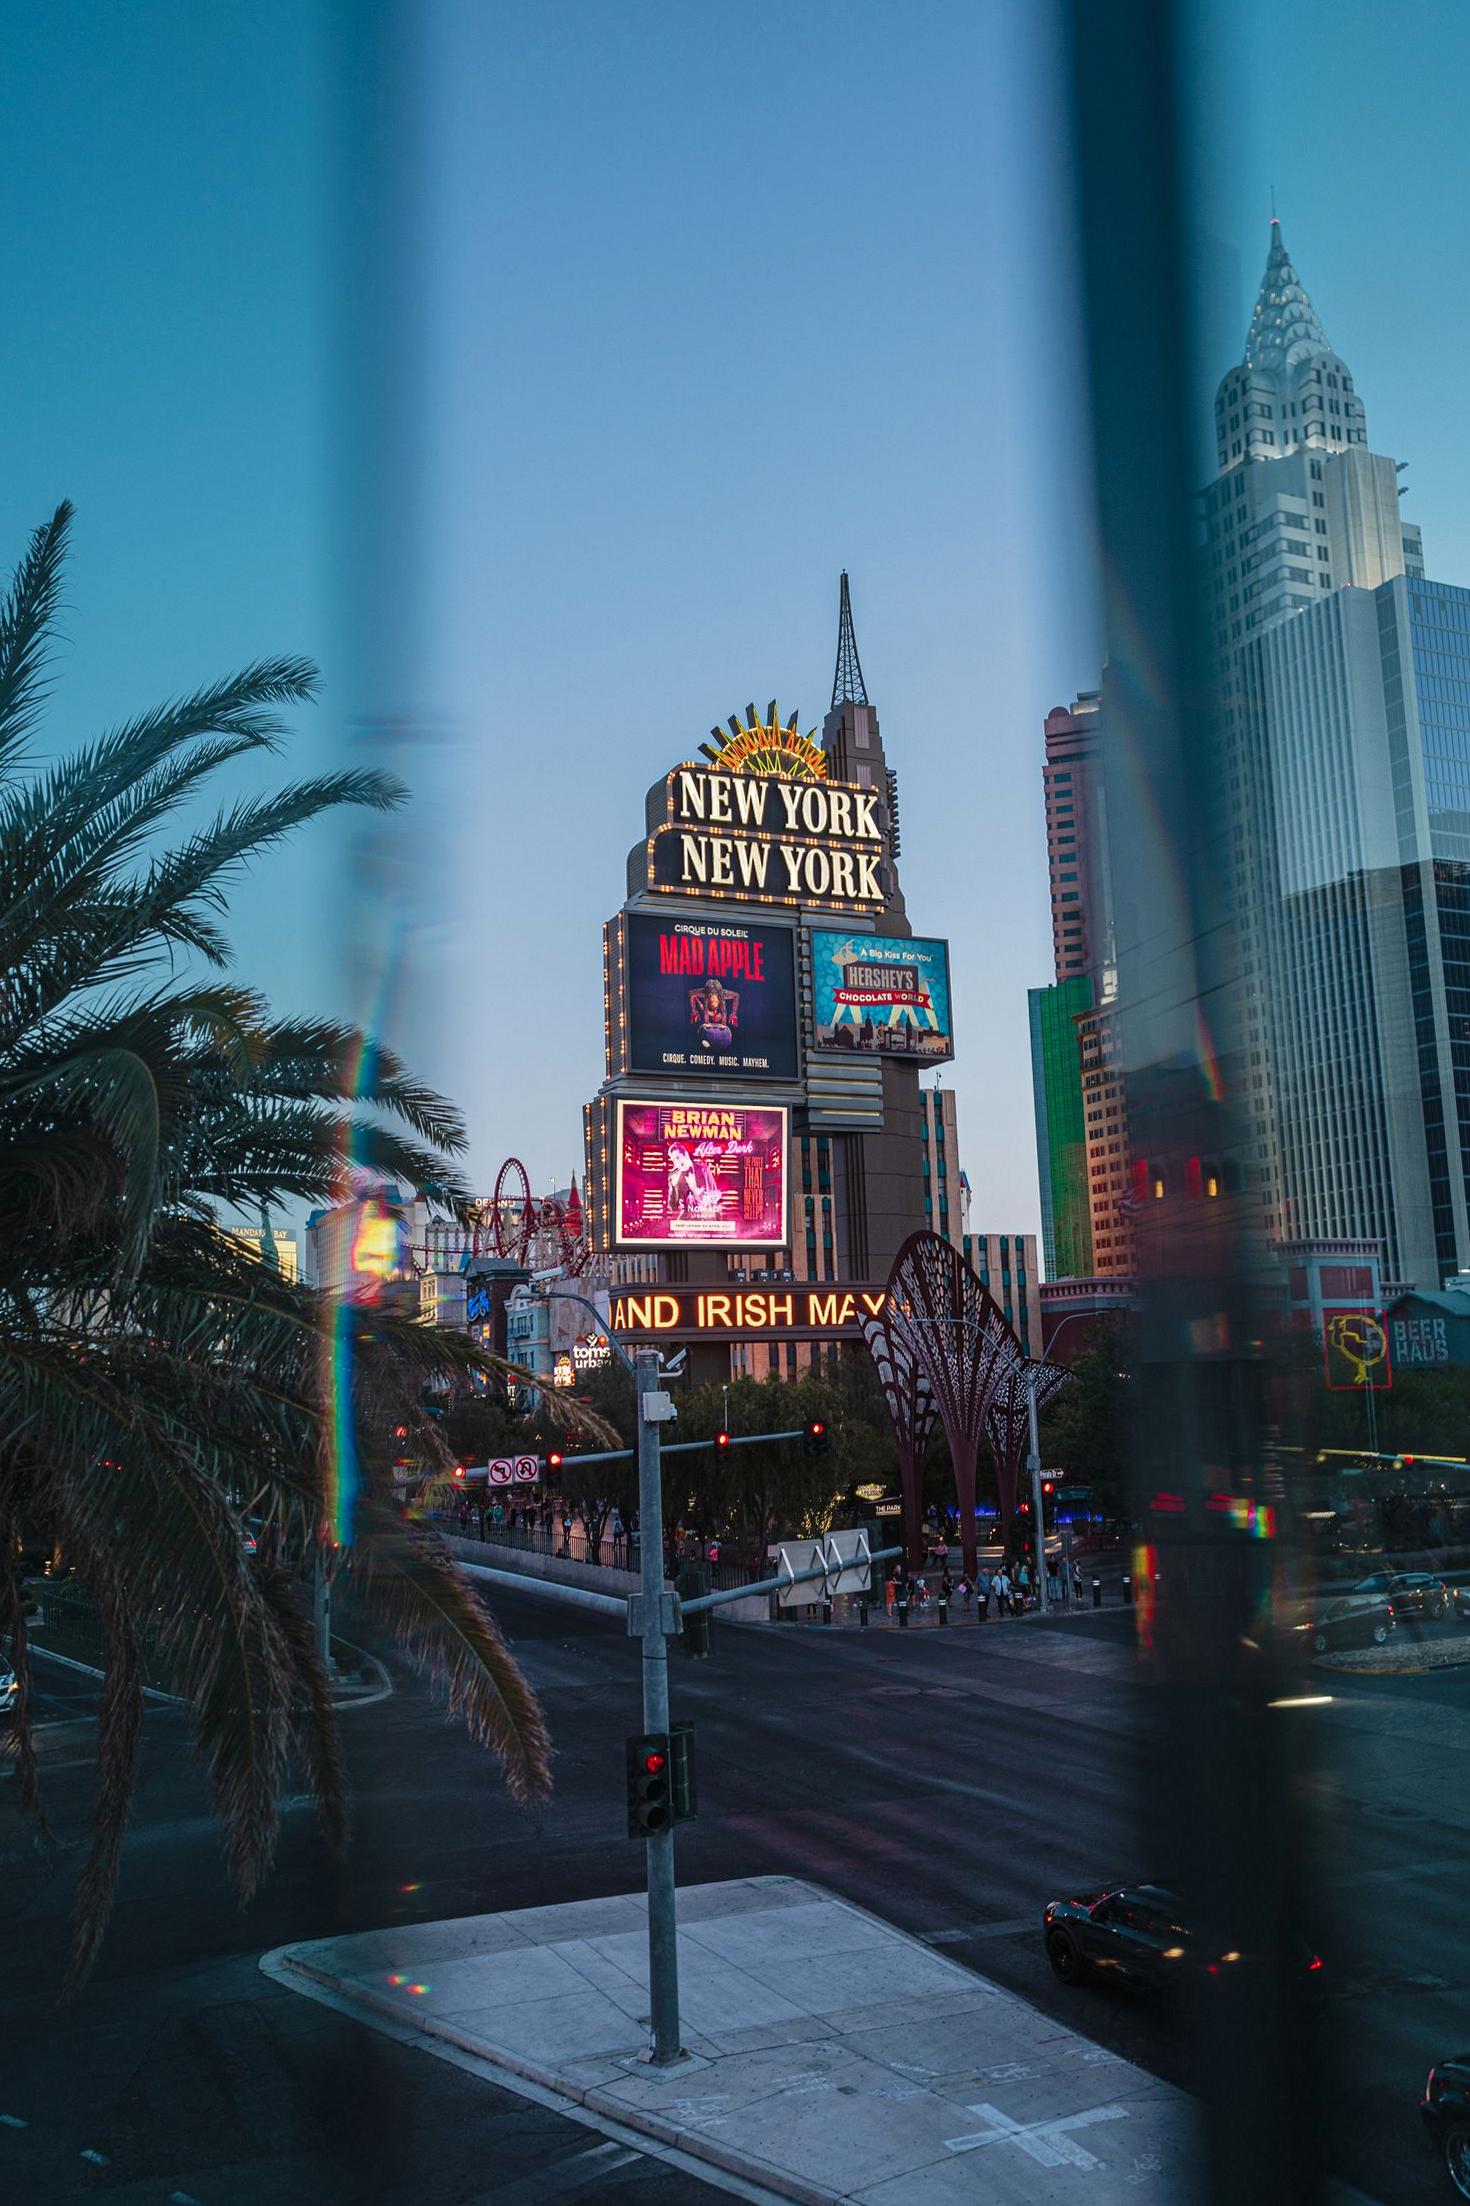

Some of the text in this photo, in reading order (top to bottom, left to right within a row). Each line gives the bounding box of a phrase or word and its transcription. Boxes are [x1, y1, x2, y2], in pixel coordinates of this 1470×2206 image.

[679, 771, 882, 840] NEW YORK
[680, 834, 885, 900] NEW YORK
[674, 924, 706, 936] CIRQUE
[707, 927, 720, 936] DU
[659, 934, 765, 982] MAD APPLE
[860, 948, 868, 957] A
[869, 949, 883, 959] Big
[884, 951, 901, 960] Kiss
[902, 952, 915, 961] For
[849, 965, 914, 990] HERSHEY'S
[839, 992, 924, 1003] CHOCOLATE WORLD
[662, 1053, 770, 1068] CIRQUE. COMEDY. MUSIC. MAYHEM.
[672, 1110, 735, 1126] BRIAN
[664, 1124, 742, 1140] NEWMAN
[692, 1140, 753, 1157] After Dark
[744, 1167, 763, 1189] THAT
[273, 1230, 288, 1239] BAY
[698, 1295, 793, 1327] IRISH
[809, 1294, 912, 1326] MAY
[1394, 1318, 1447, 1341] BEER
[573, 1345, 611, 1360] toms
[1396, 1340, 1449, 1362] HAUS
[875, 1504, 902, 1513] THE PARK
